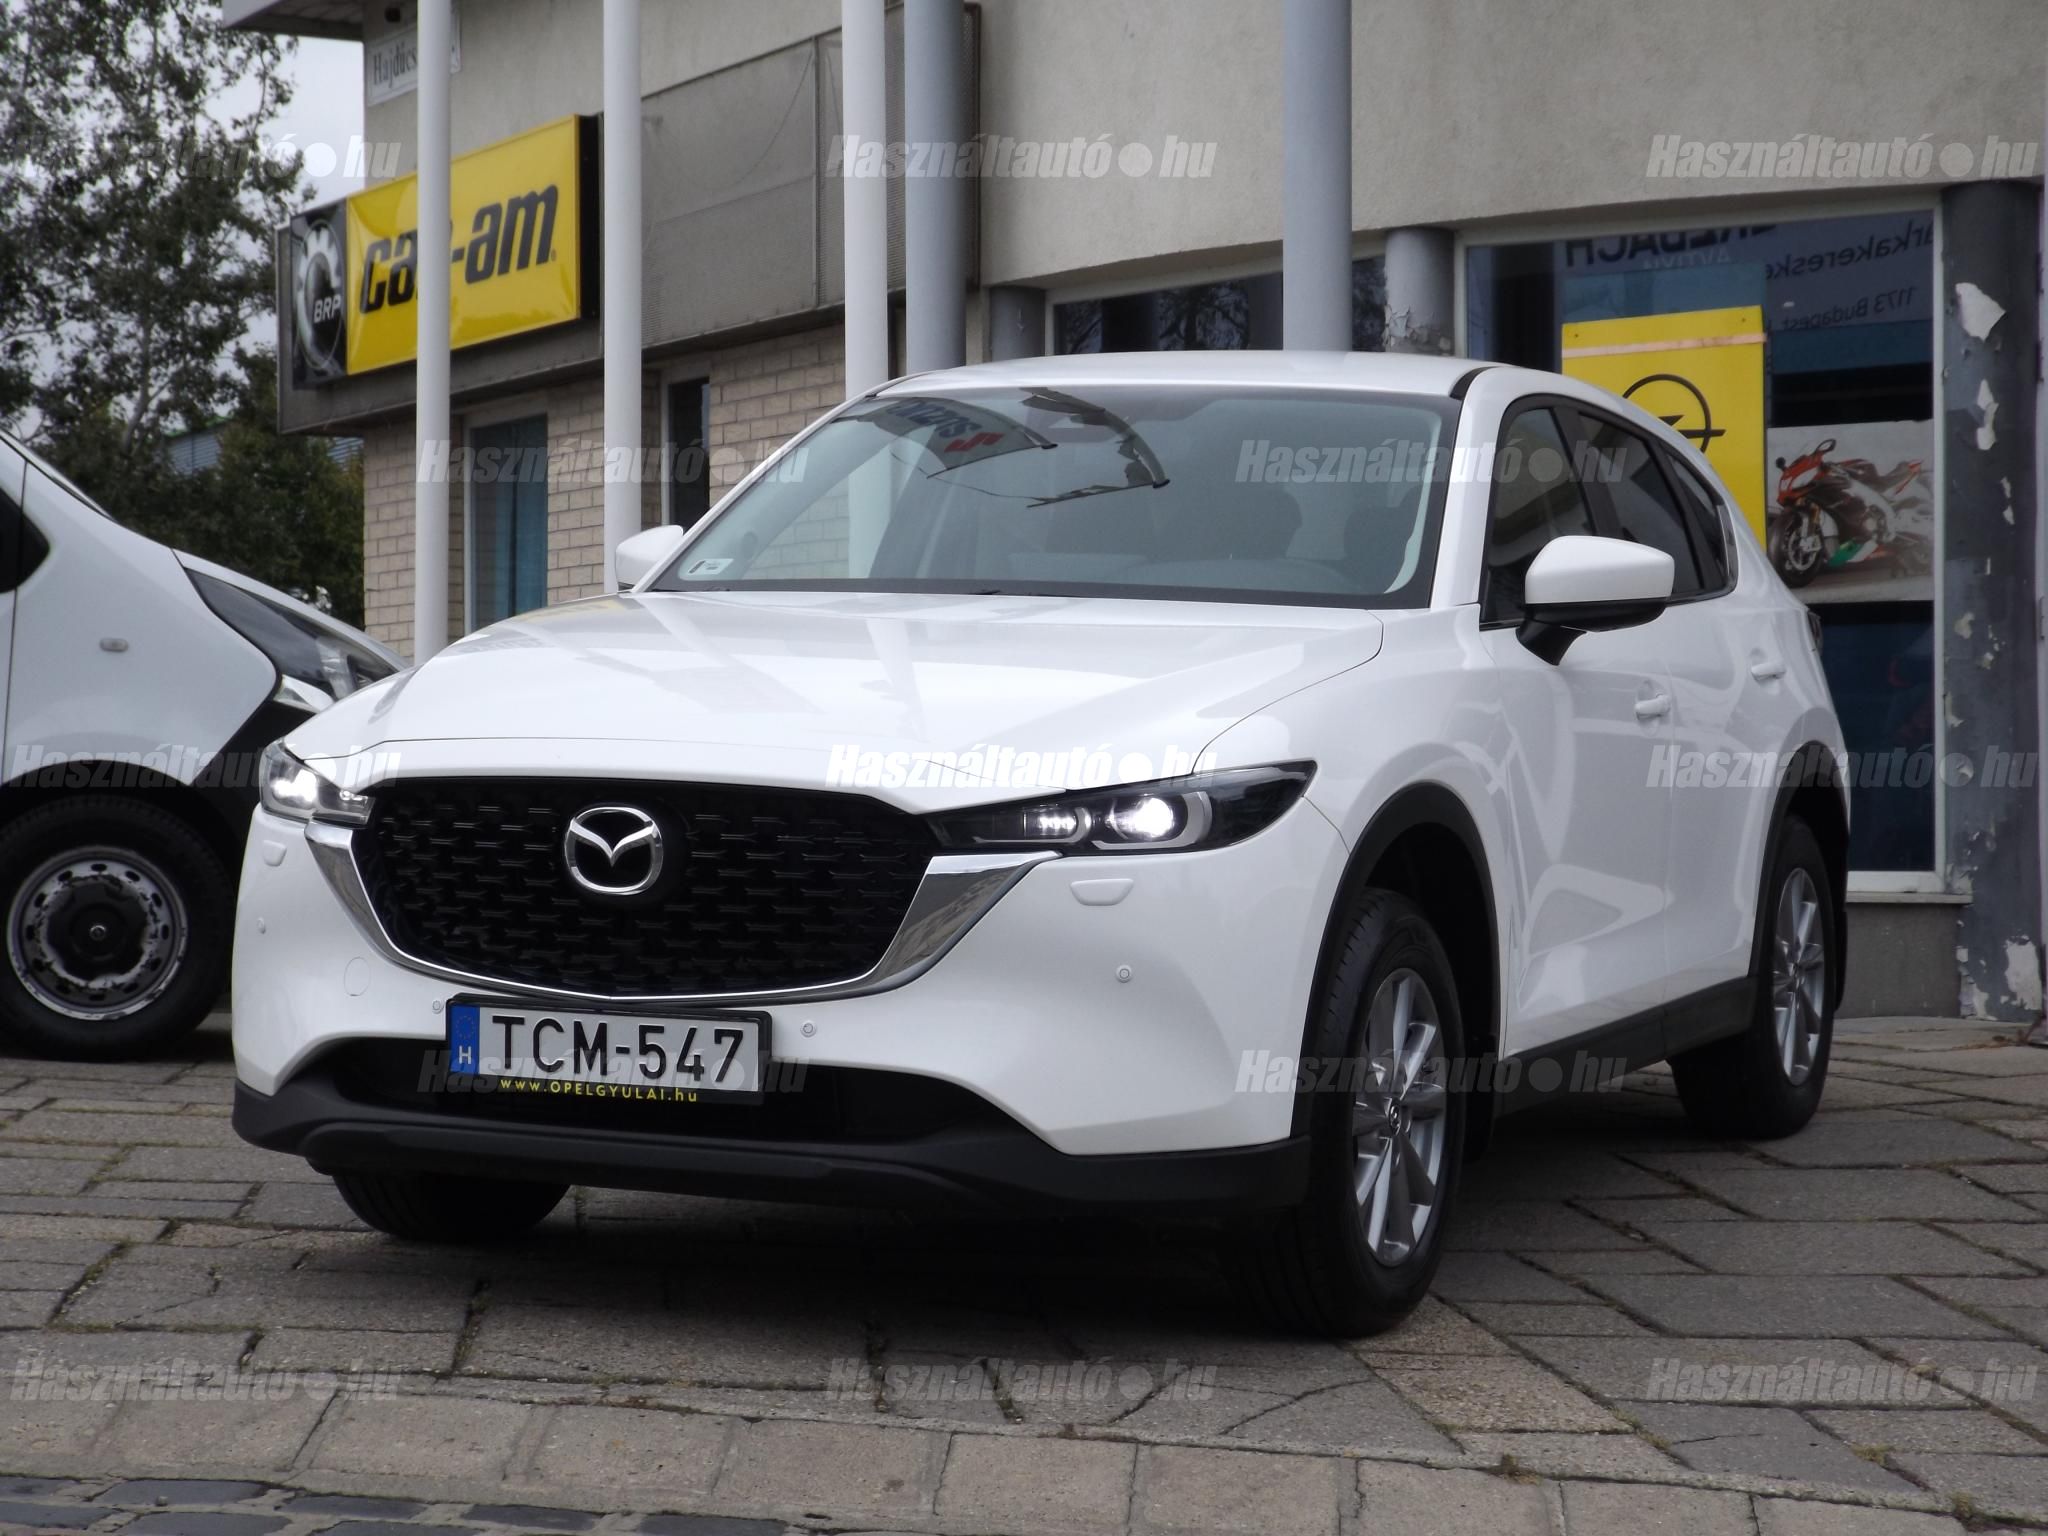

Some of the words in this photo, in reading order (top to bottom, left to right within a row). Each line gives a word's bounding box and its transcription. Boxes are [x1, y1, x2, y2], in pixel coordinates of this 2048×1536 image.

[313, 294, 342, 323] BRP
[458, 1045, 472, 1065] H
[492, 1015, 744, 1084] TCM-547
[500, 1079, 697, 1103] www.OPELGYULAI.hu
